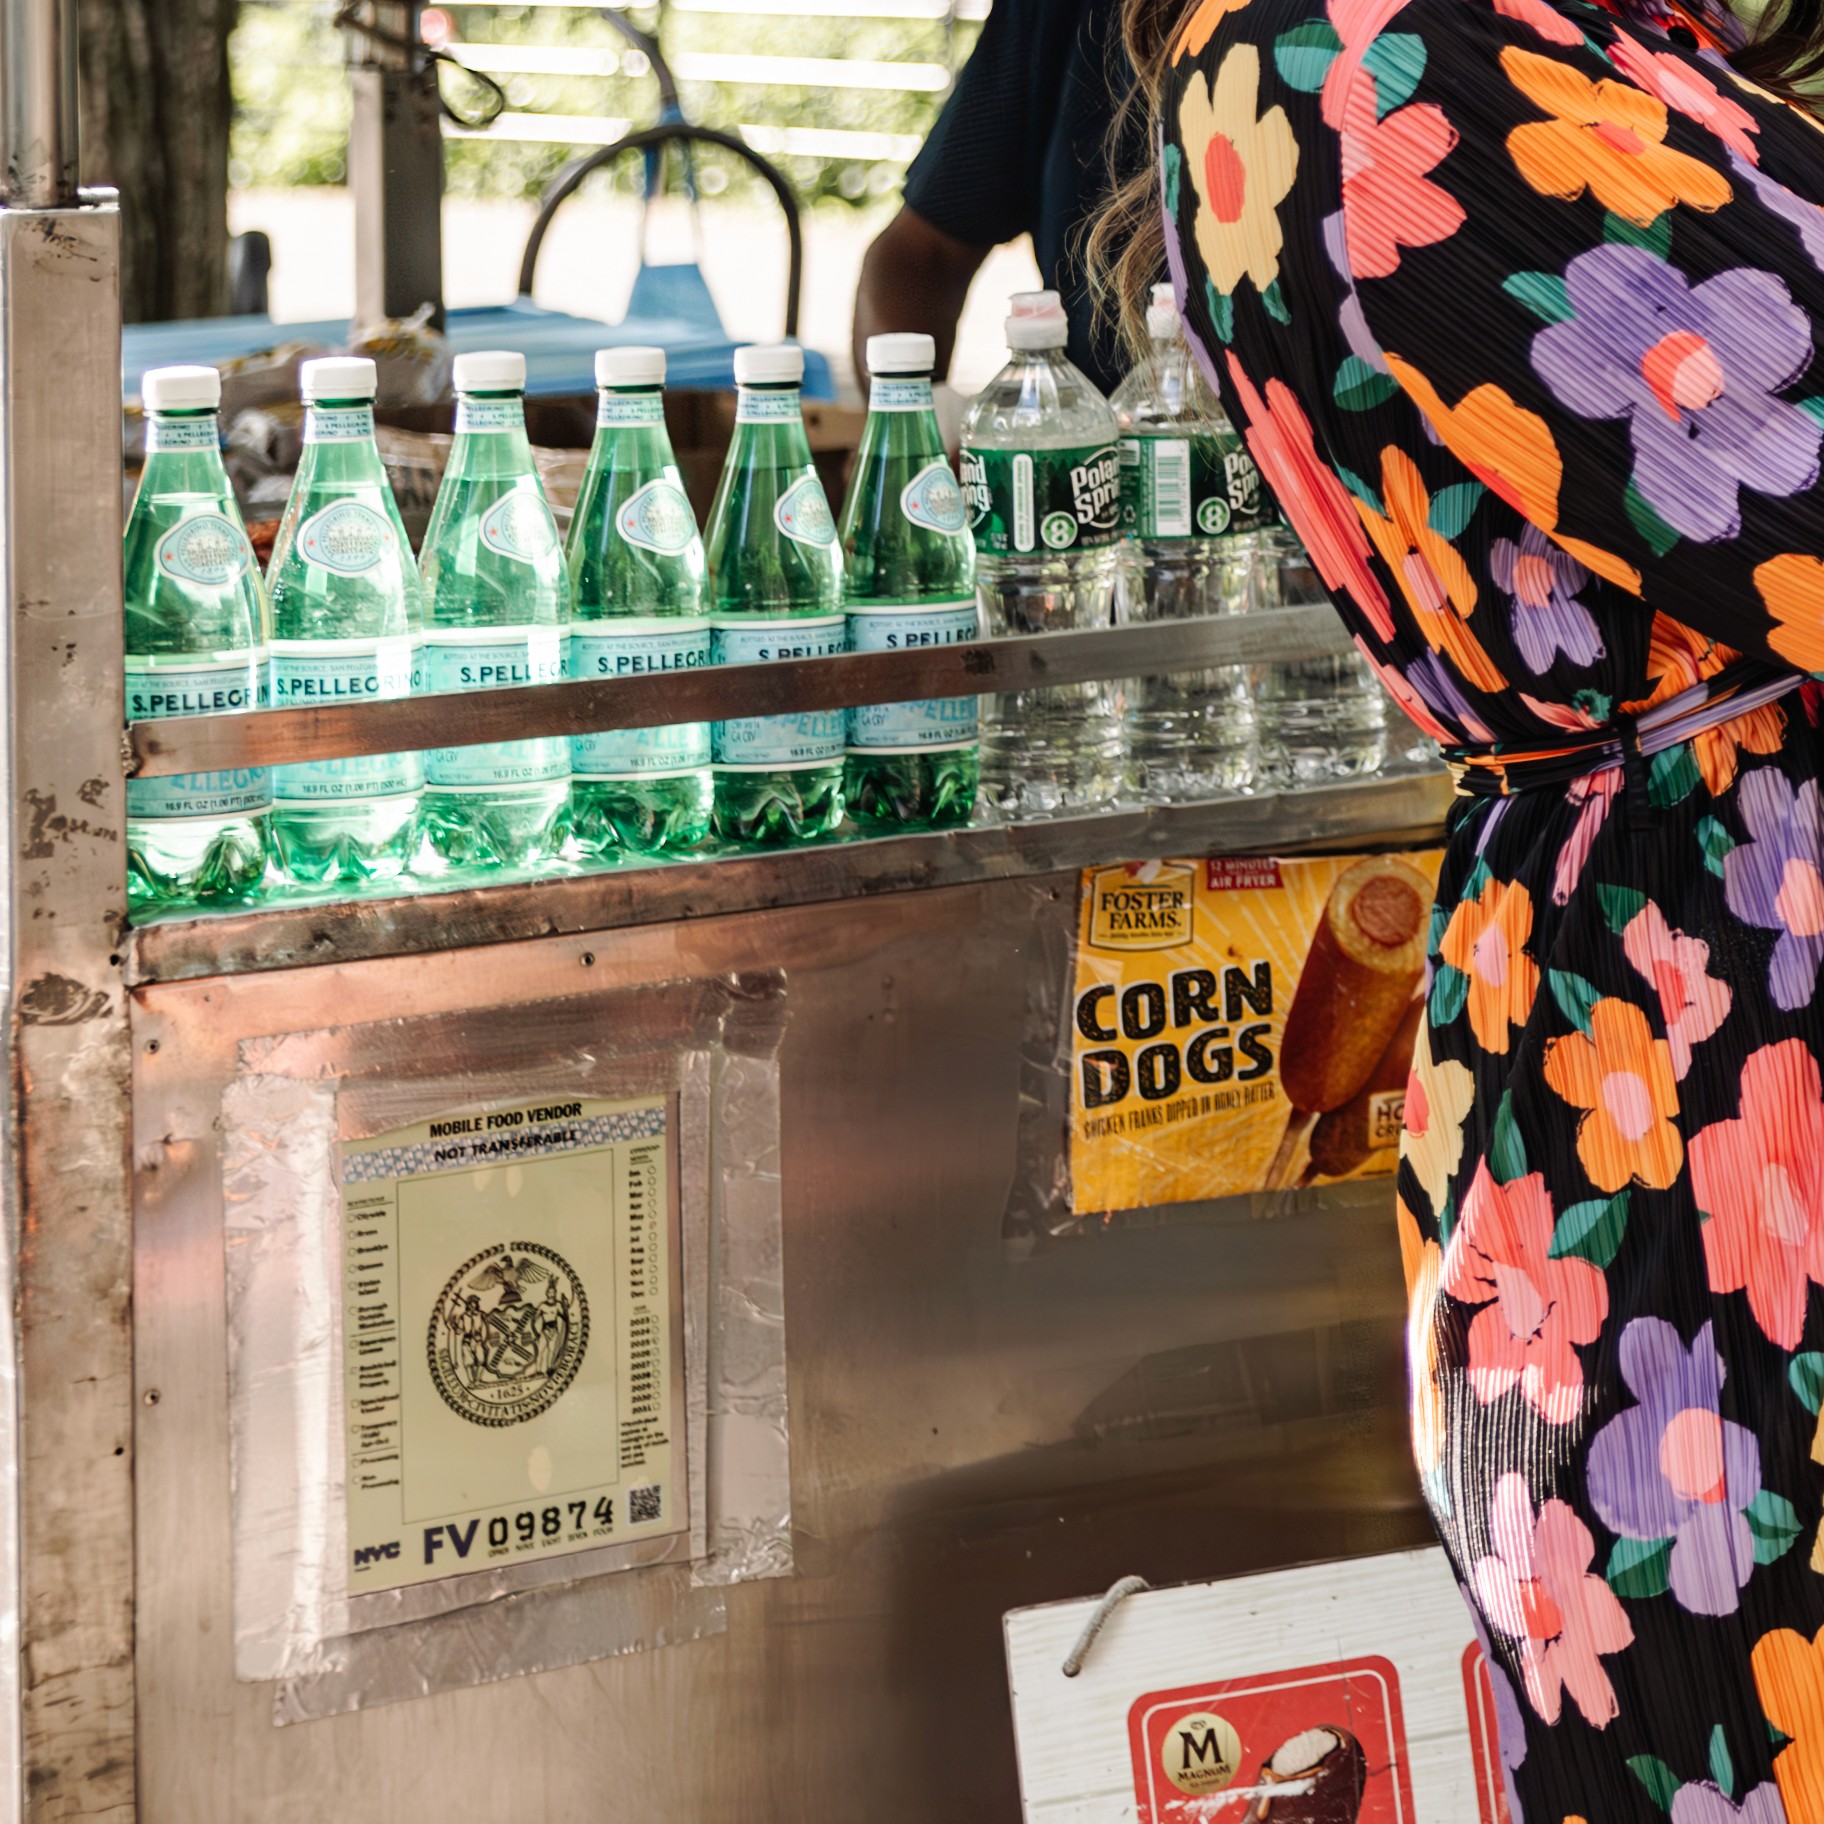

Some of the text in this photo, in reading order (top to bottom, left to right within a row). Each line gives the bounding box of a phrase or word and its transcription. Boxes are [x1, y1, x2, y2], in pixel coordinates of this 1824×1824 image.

[1051, 515, 1069, 543] 8
[1206, 501, 1223, 531] 8
[1209, 873, 1278, 889] AIR FRYER
[1100, 890, 1185, 912] FOSTER
[1108, 908, 1183, 930] FARMS.
[1075, 960, 1274, 1043] CORN
[1078, 1022, 1274, 1109] DOGS
[429, 1102, 583, 1139] MOBILE FOOD VENDOR
[1084, 1108, 1127, 1141] CHICKEN
[1128, 1100, 1164, 1134] FRANKS
[1166, 1093, 1200, 1125] DIPPED
[1214, 1087, 1243, 1112] HONEY
[1243, 1081, 1276, 1109] BATTER
[434, 1129, 578, 1163] NOT TRANSFERABLE
[423, 1496, 614, 1565] FV 09874
[353, 1541, 401, 1567] NYC
[1179, 1727, 1226, 1770] M
[1176, 1764, 1232, 1786] MAGNUM
